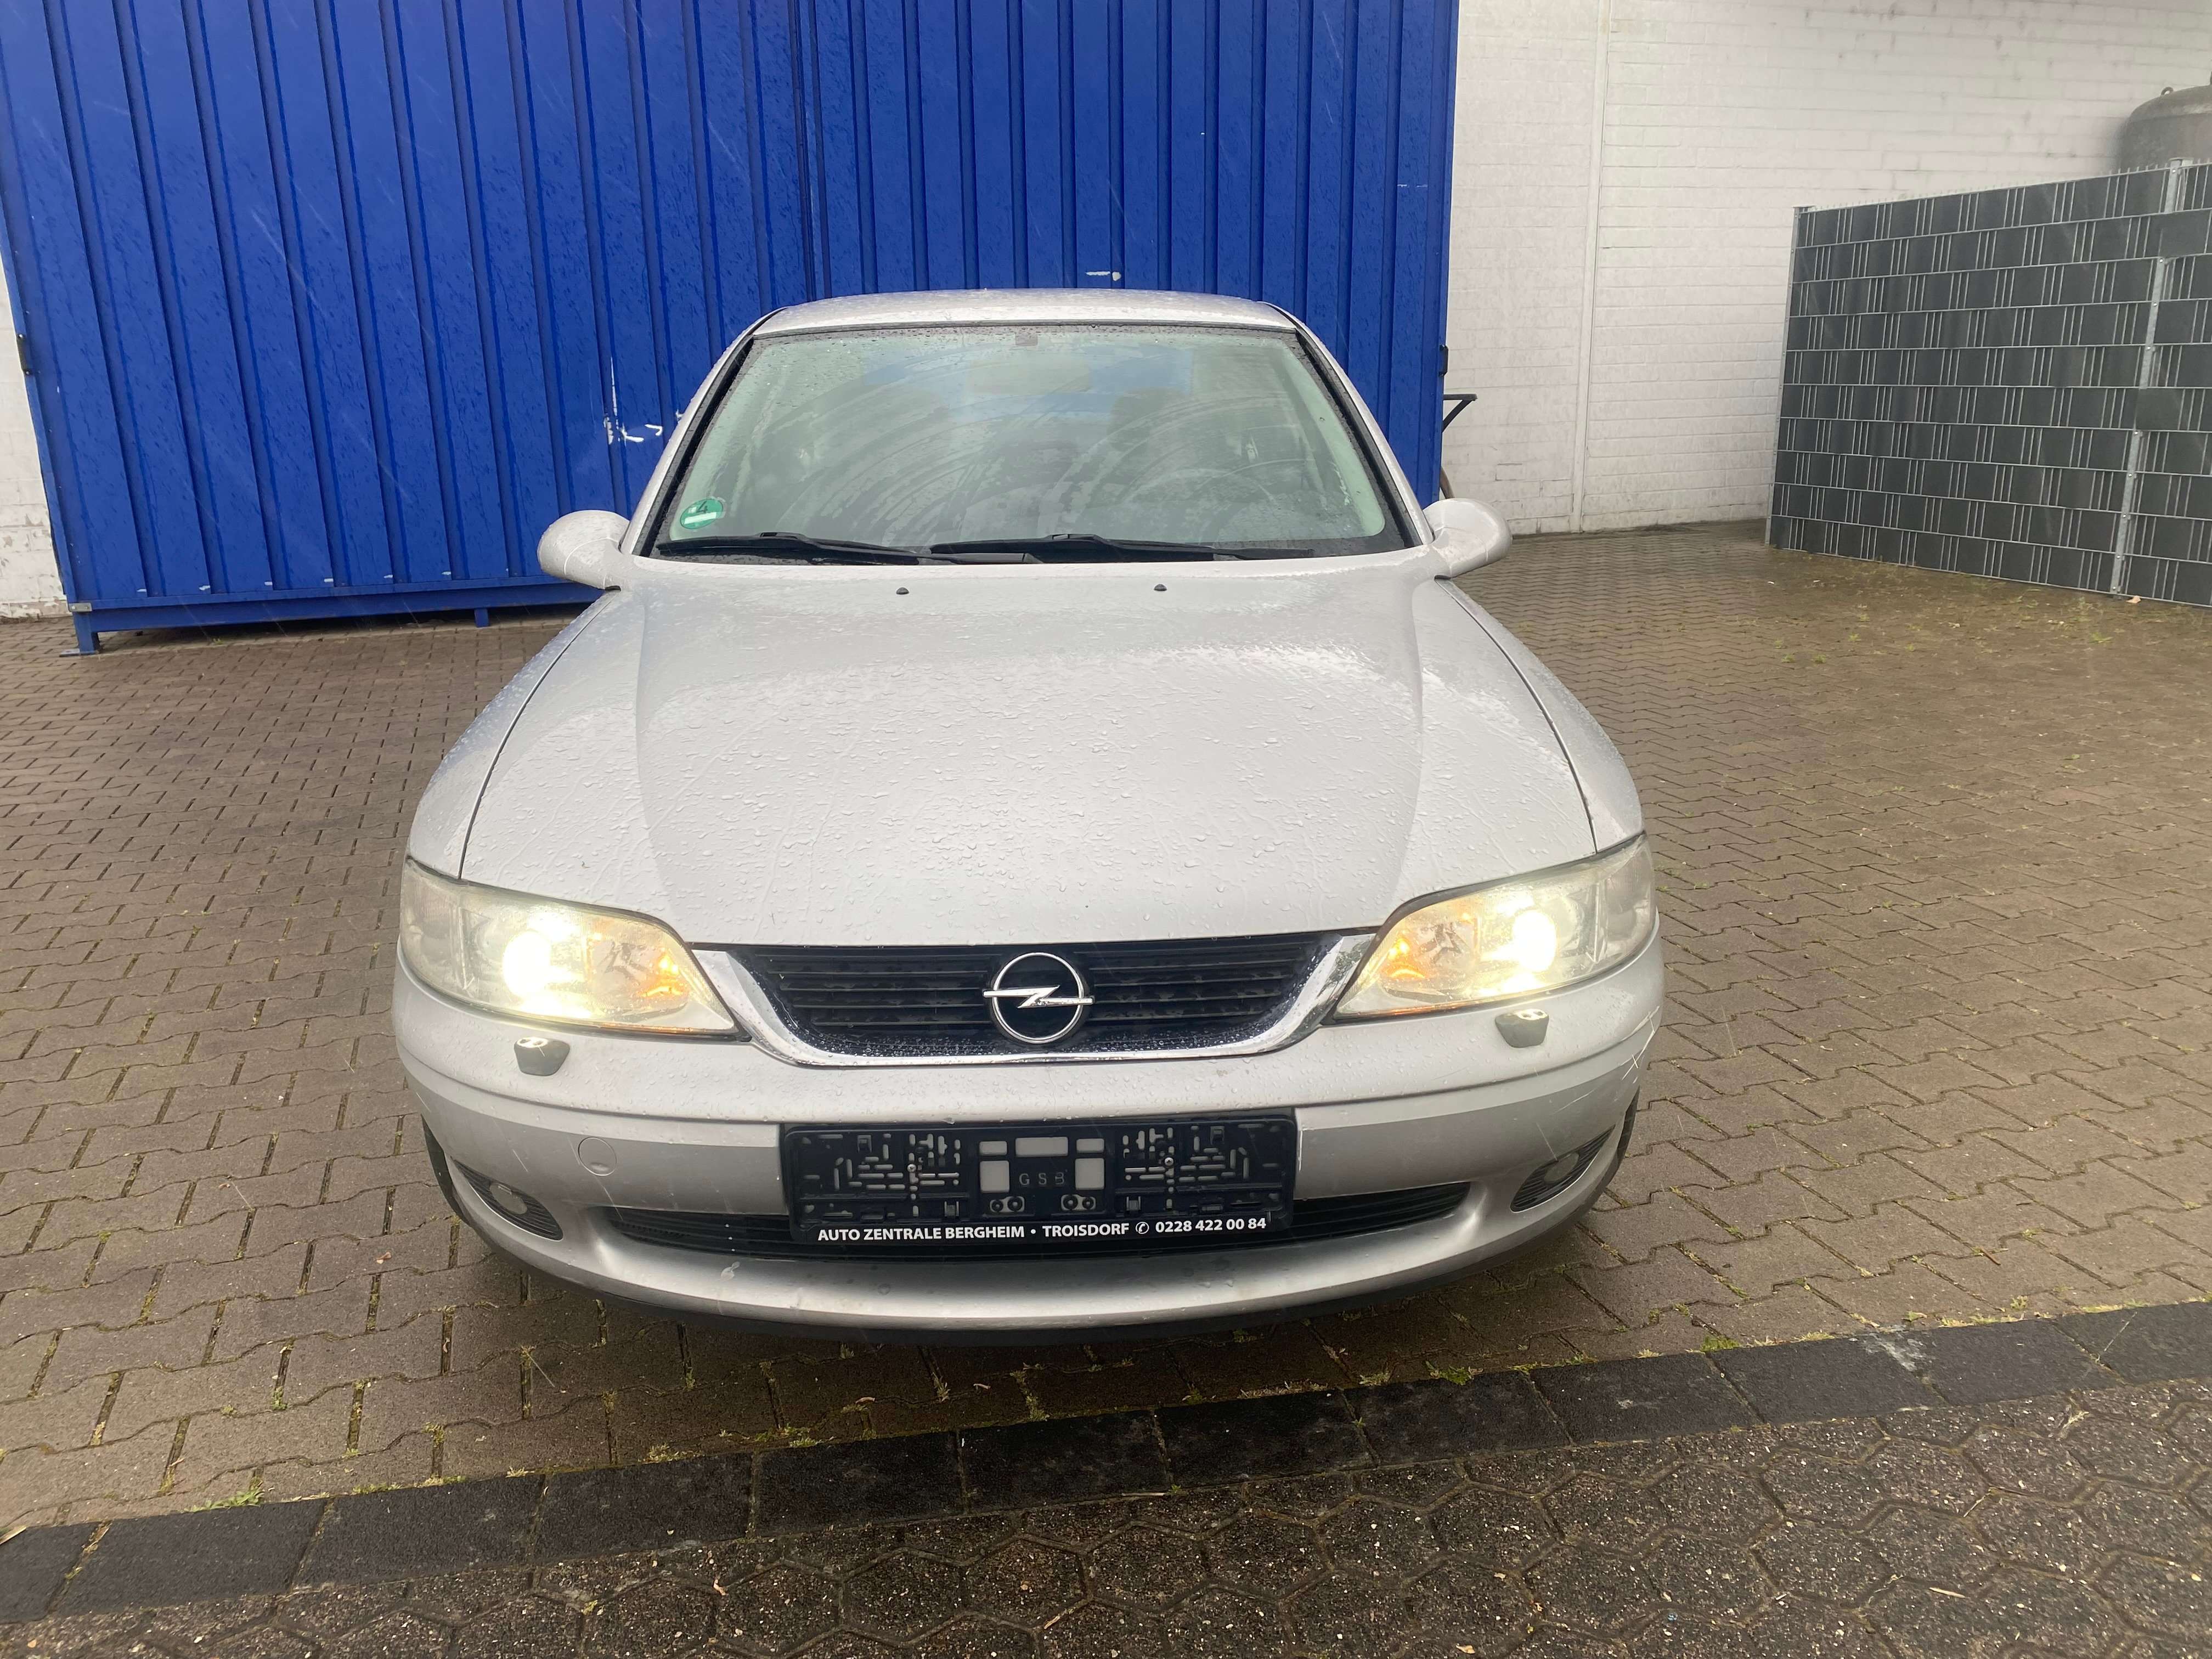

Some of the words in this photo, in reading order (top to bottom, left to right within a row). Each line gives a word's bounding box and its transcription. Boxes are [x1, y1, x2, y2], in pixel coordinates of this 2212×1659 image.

[817, 1228, 860, 1241] AUTO
[864, 1227, 942, 1240] ZENTRALE
[945, 1226, 1025, 1239] BERGHEIM
[1042, 1223, 1130, 1237] TROISDORF
[1155, 1221, 1192, 1233] 0228
[1195, 1219, 1223, 1232] 422
[1226, 1218, 1245, 1231] 00
[1248, 1217, 1267, 1229] 84
